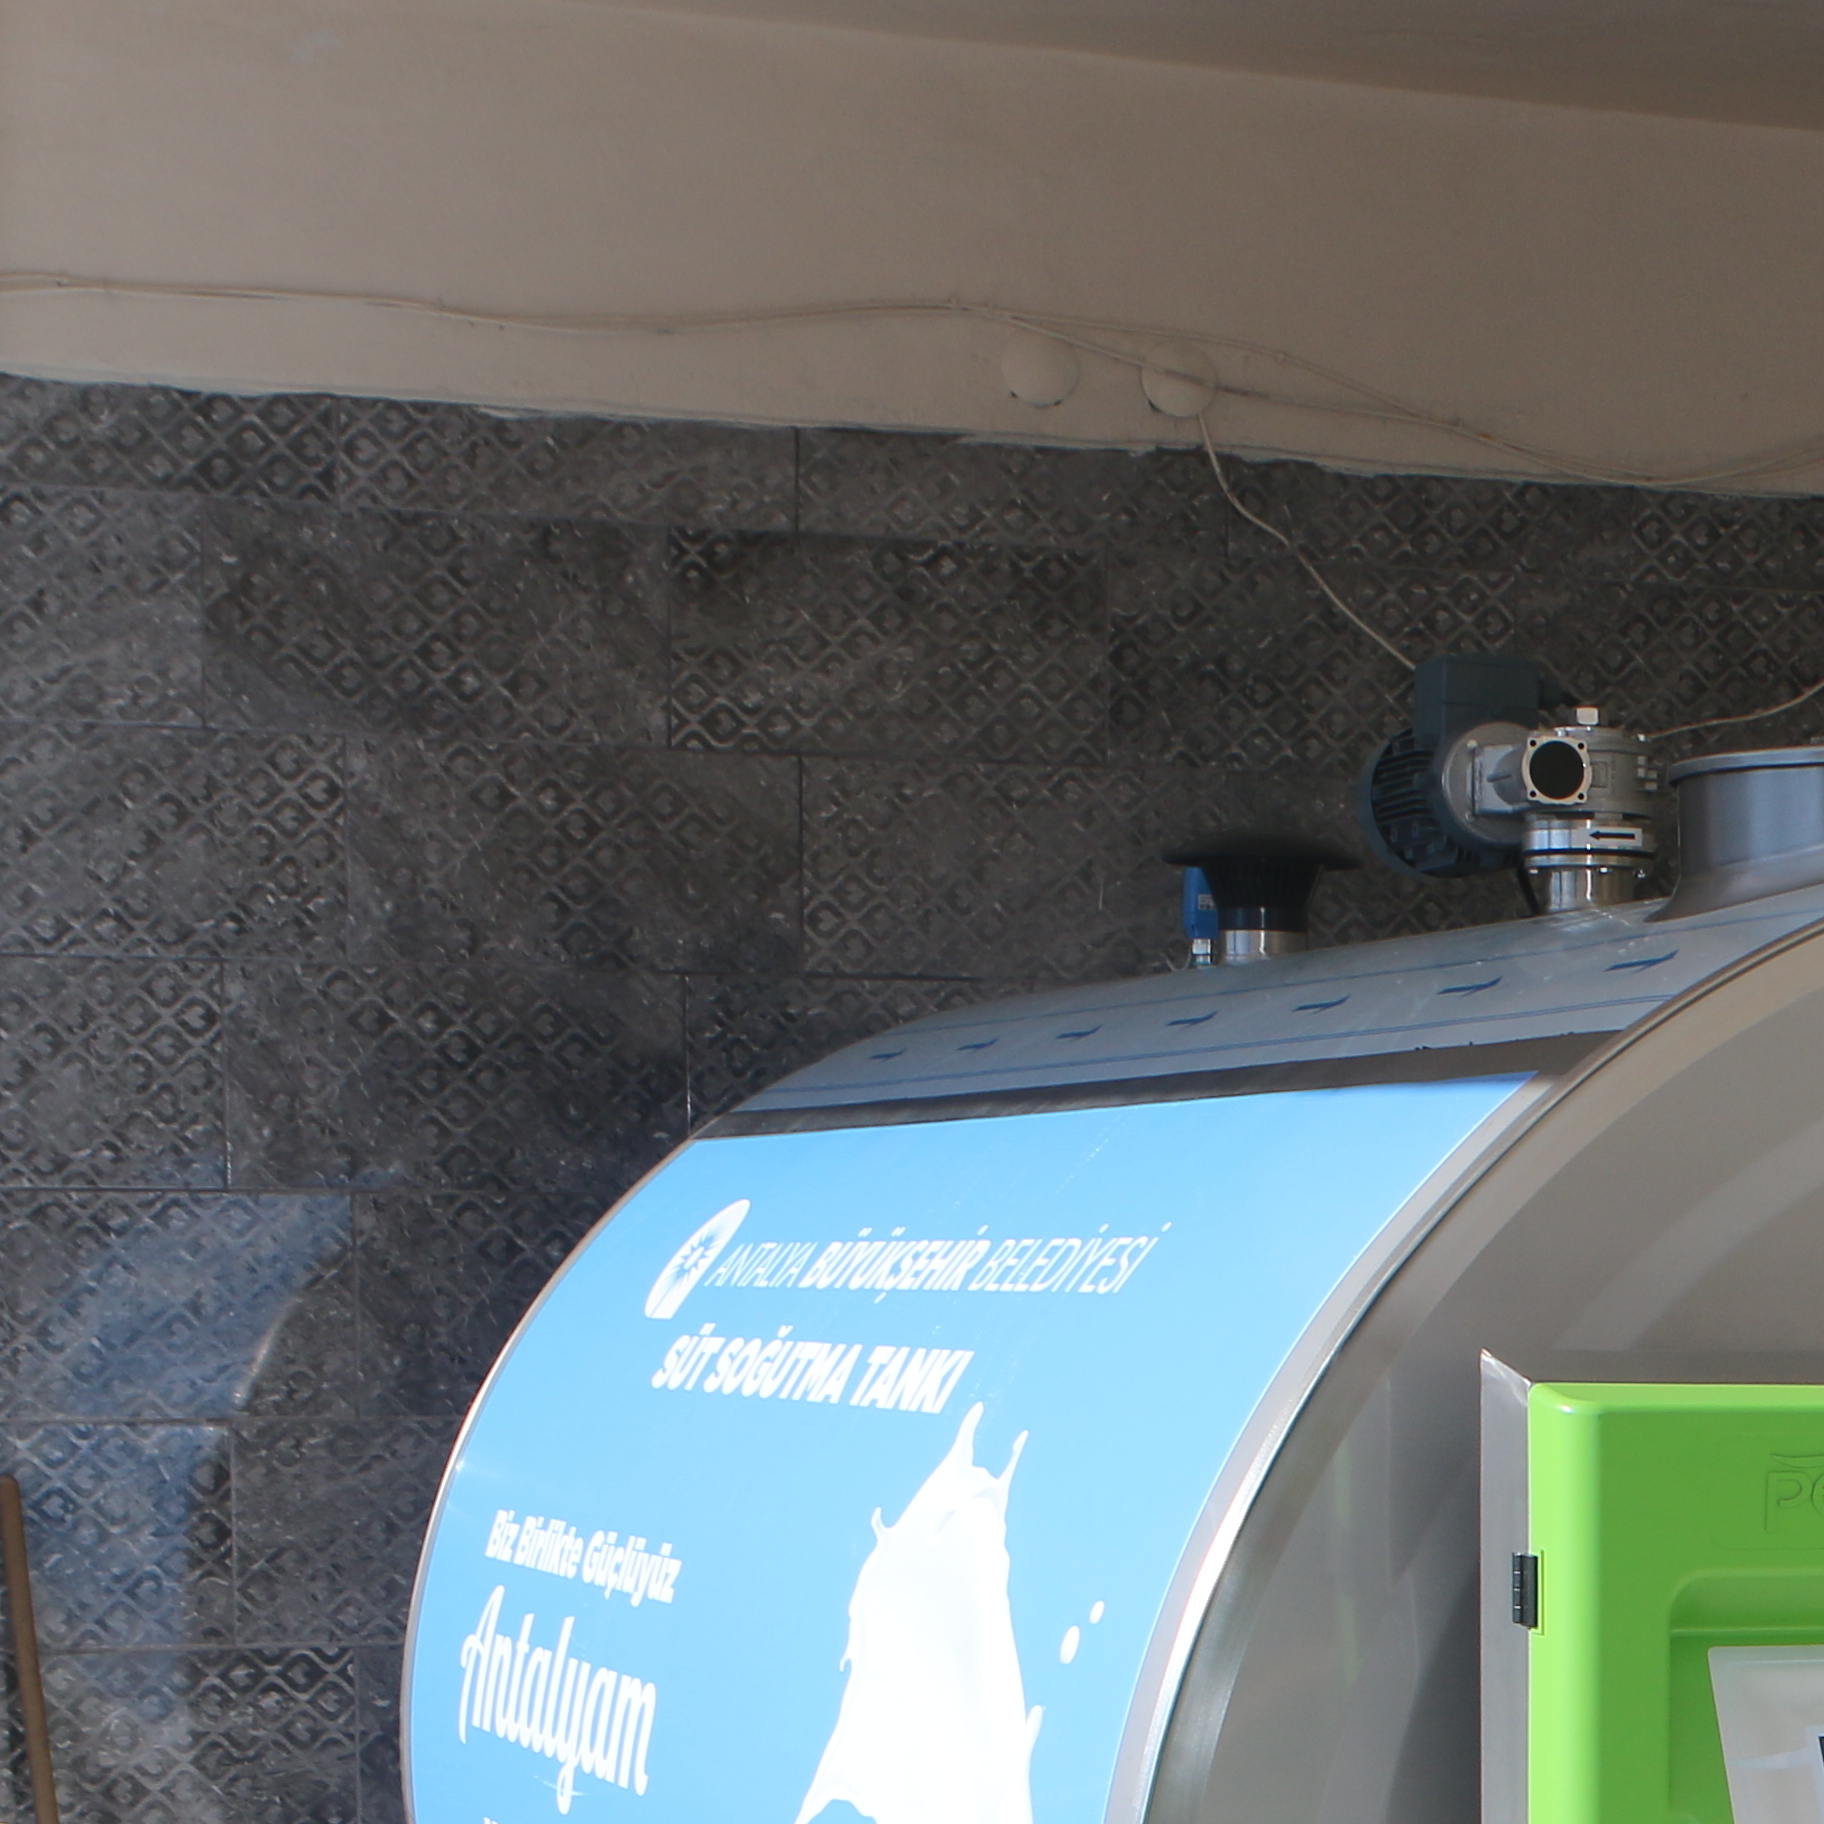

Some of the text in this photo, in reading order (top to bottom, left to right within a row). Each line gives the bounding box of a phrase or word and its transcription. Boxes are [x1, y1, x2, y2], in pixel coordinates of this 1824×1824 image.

[704, 1222, 1172, 1304] ANTALYA BÜYÜKŞEHİR BELEDİYESİ
[651, 1323, 975, 1415] SÜT SOĞUTMA TANKI
[485, 1509, 683, 1608] Biz Birlikte Güçlüyüz
[458, 1584, 656, 1815] Antalyam
